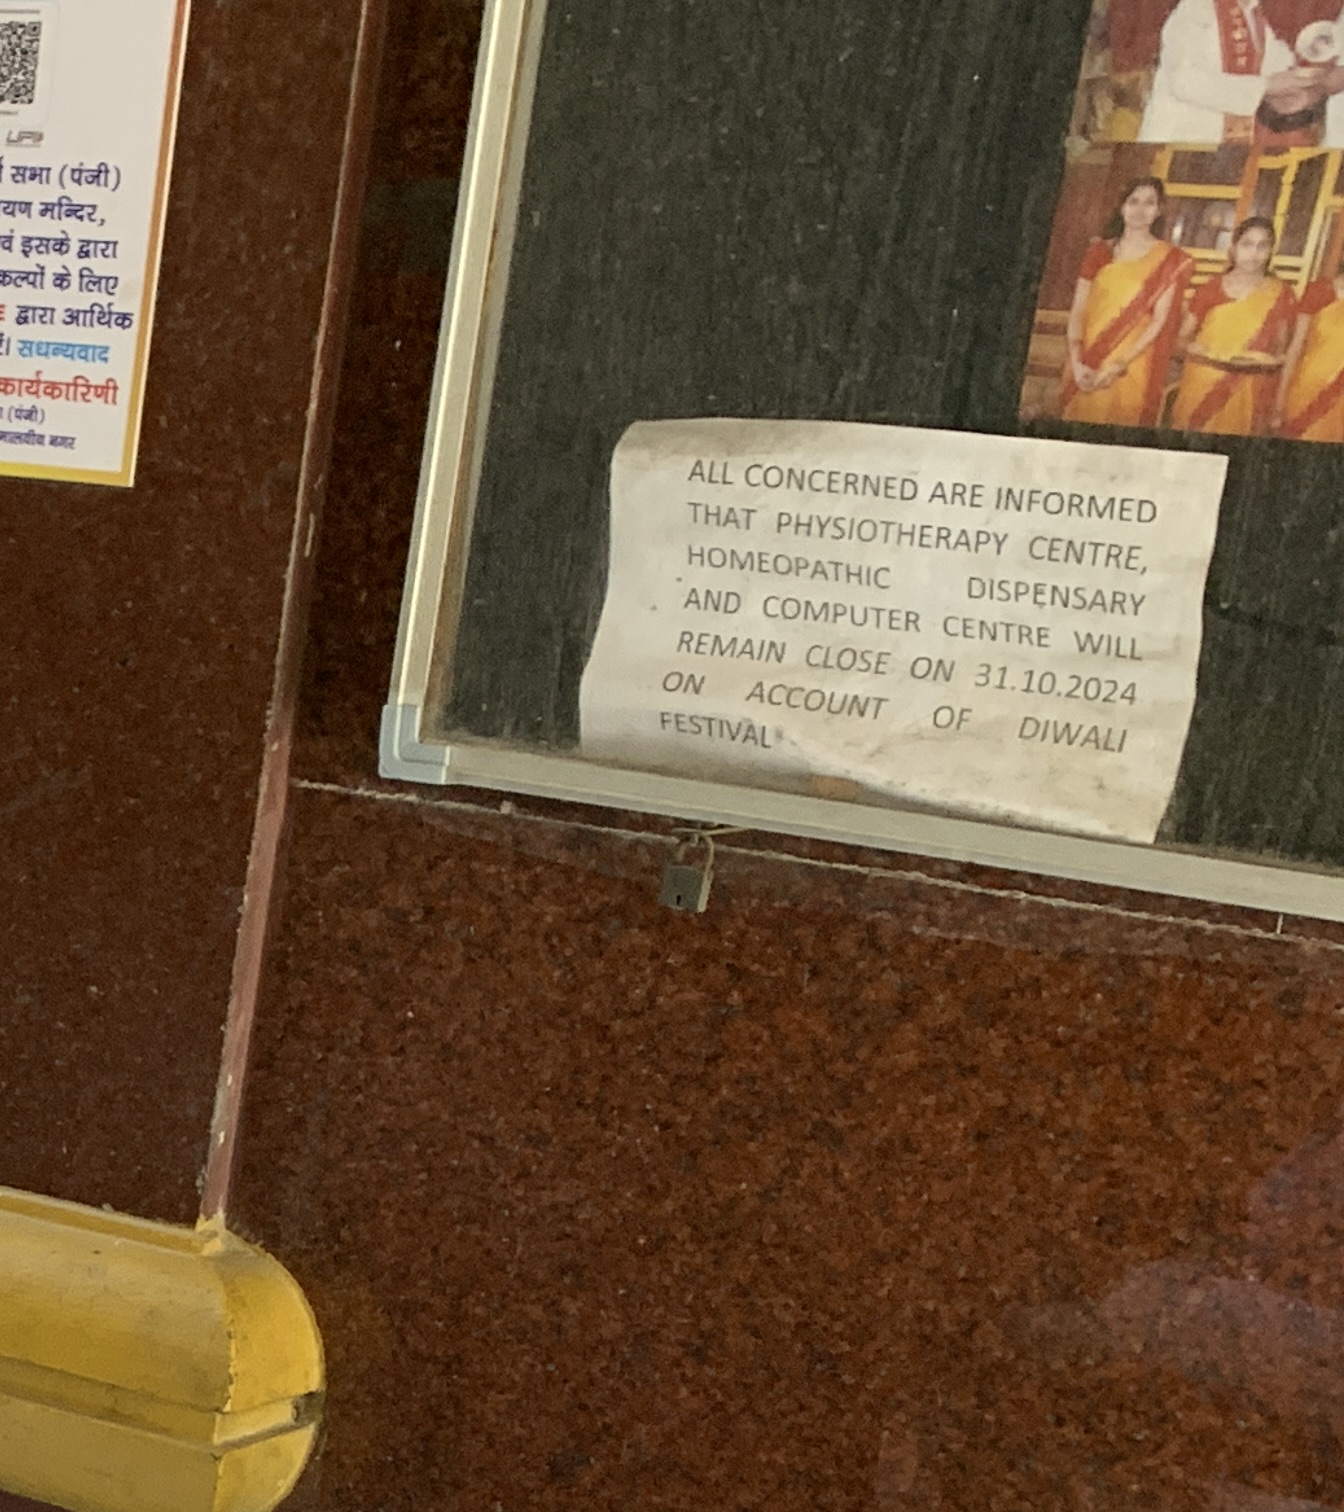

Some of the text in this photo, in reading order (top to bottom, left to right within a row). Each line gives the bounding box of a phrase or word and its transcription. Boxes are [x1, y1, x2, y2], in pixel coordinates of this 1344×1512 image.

[11, 165, 51, 184] सभा
[58, 162, 121, 191] (पंजी)
[39, 196, 106, 227] मन्दिर,
[21, 231, 71, 257] इसके
[77, 238, 119, 259] द्वारा
[52, 265, 71, 292] के
[79, 266, 119, 295] लिए
[15, 304, 56, 325] द्वारा
[62, 302, 134, 330] आर्थिक
[17, 338, 110, 363] सधन्यवाद
[688, 459, 1158, 524] ALL CONCERNED ARE INFORMED
[688, 501, 1148, 575] THAT PHYSIOTHERAPY CENTRE,
[687, 544, 1147, 617] HOMEOPATHIC DISPENSARY
[684, 587, 1144, 660] AND COMPUTER CENTRE WILL
[676, 630, 1138, 706] REMAIN CLOSE ON 31.10.2024
[659, 710, 773, 750] FESTIVAL
[661, 670, 1128, 754] ON ACCOUNT OF DIWALI
